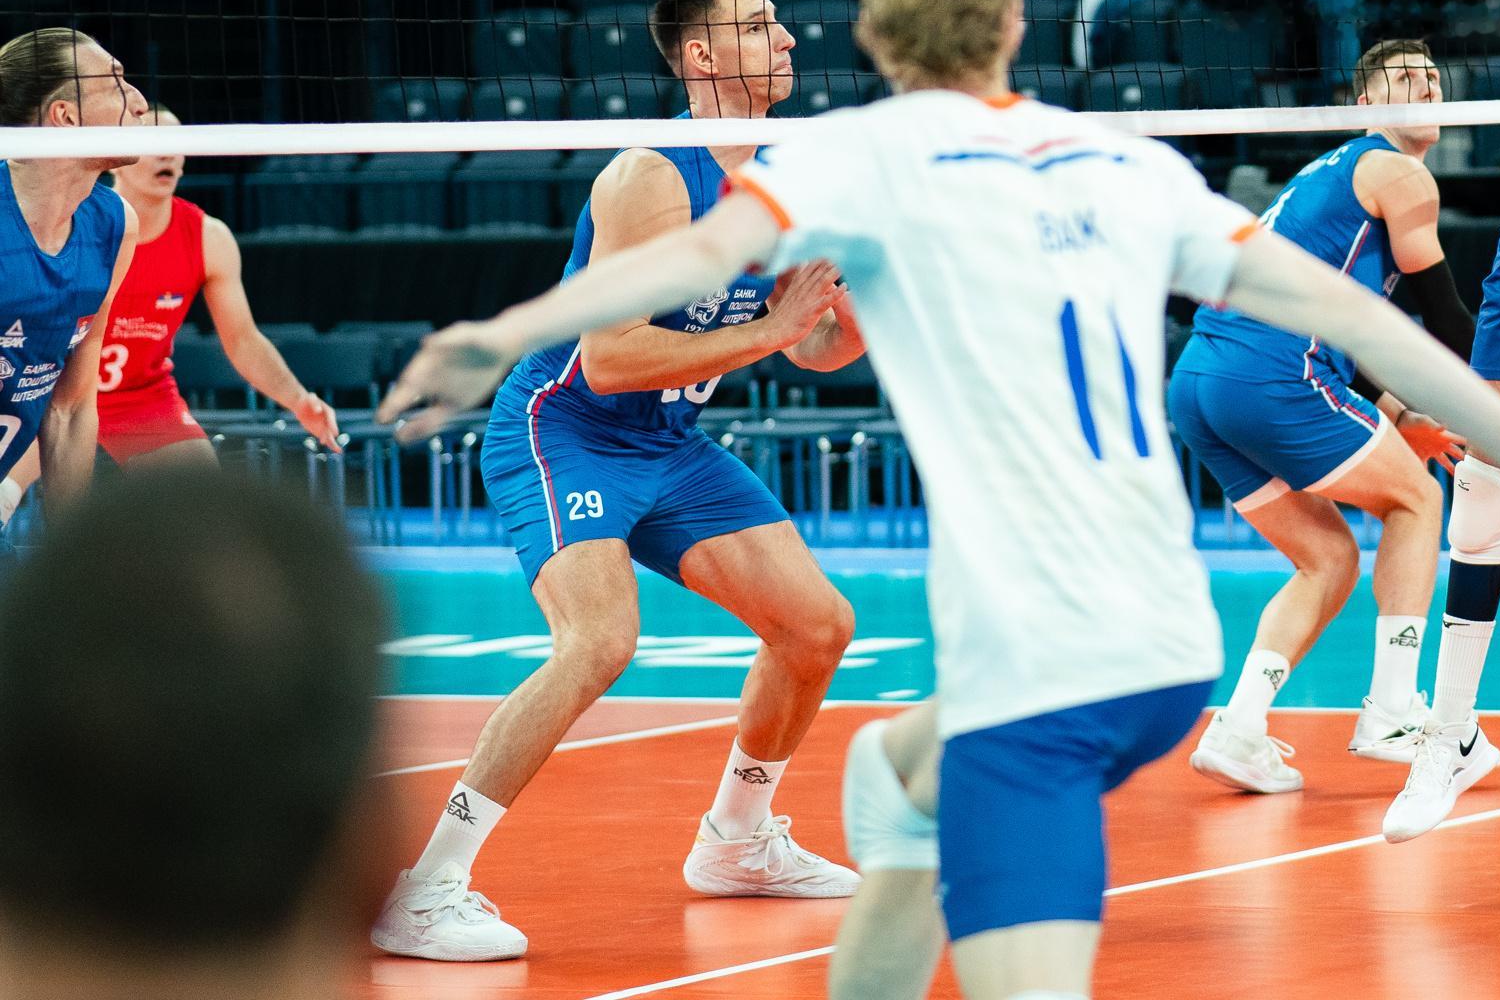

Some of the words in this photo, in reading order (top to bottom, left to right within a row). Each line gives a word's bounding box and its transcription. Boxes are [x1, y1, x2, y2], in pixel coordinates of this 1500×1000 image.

[566, 490, 604, 520] 29
[734, 767, 776, 784] PEAK
[446, 802, 479, 825] EAK
